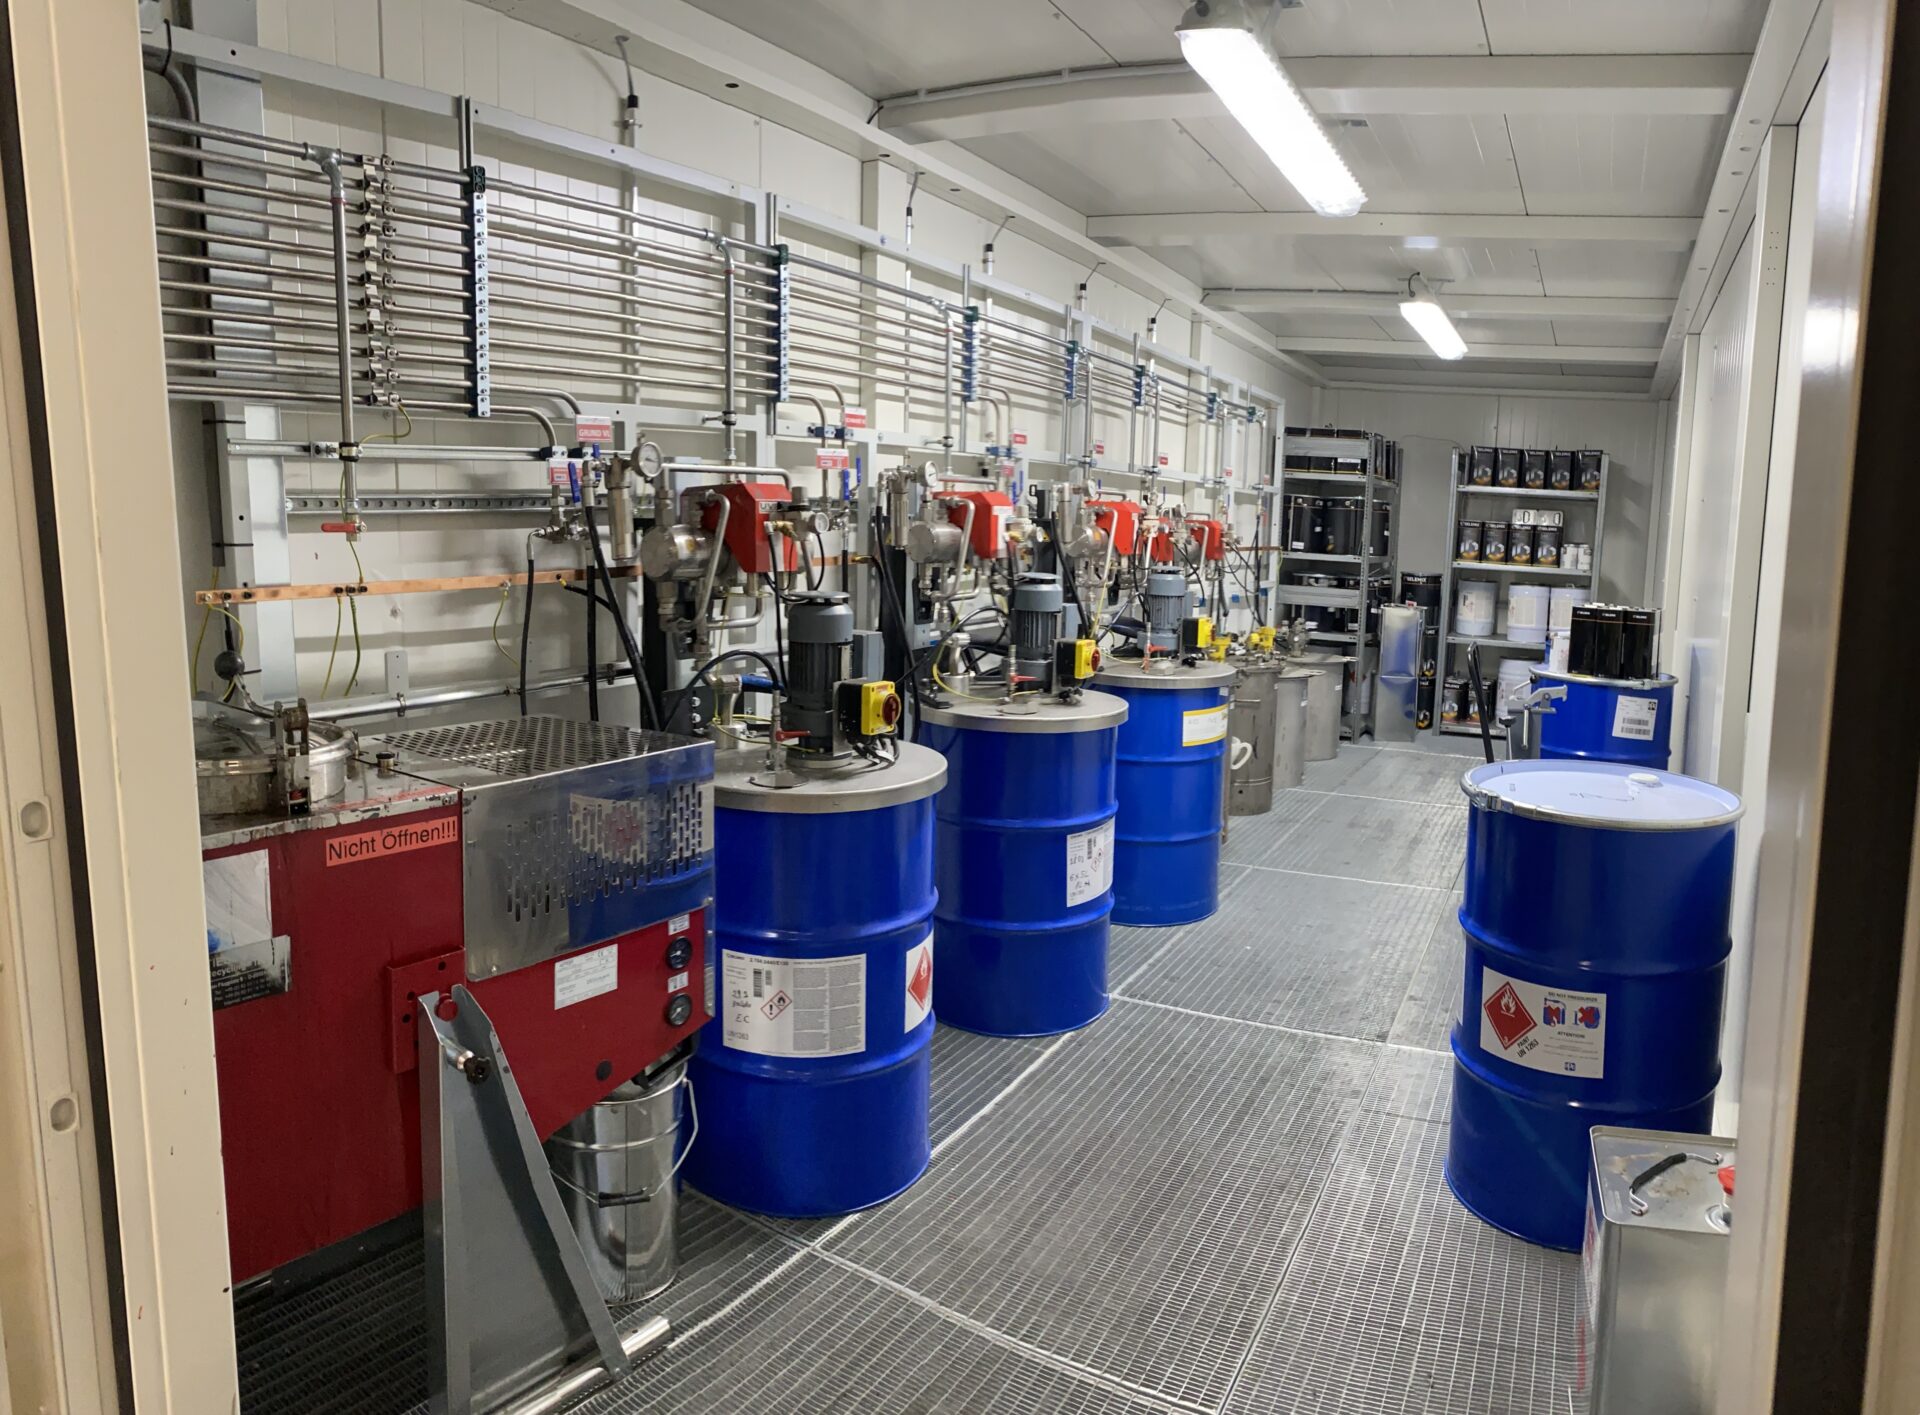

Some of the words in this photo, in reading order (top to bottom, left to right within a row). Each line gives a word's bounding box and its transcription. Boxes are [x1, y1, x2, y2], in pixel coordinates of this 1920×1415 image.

[328, 837, 377, 861] Nicht
[381, 819, 457, 850] Öffnen!!!
[1516, 1048, 1527, 1058] UN
[1524, 1038, 1539, 1052] 1263
[1517, 1035, 1530, 1049] PAINT
